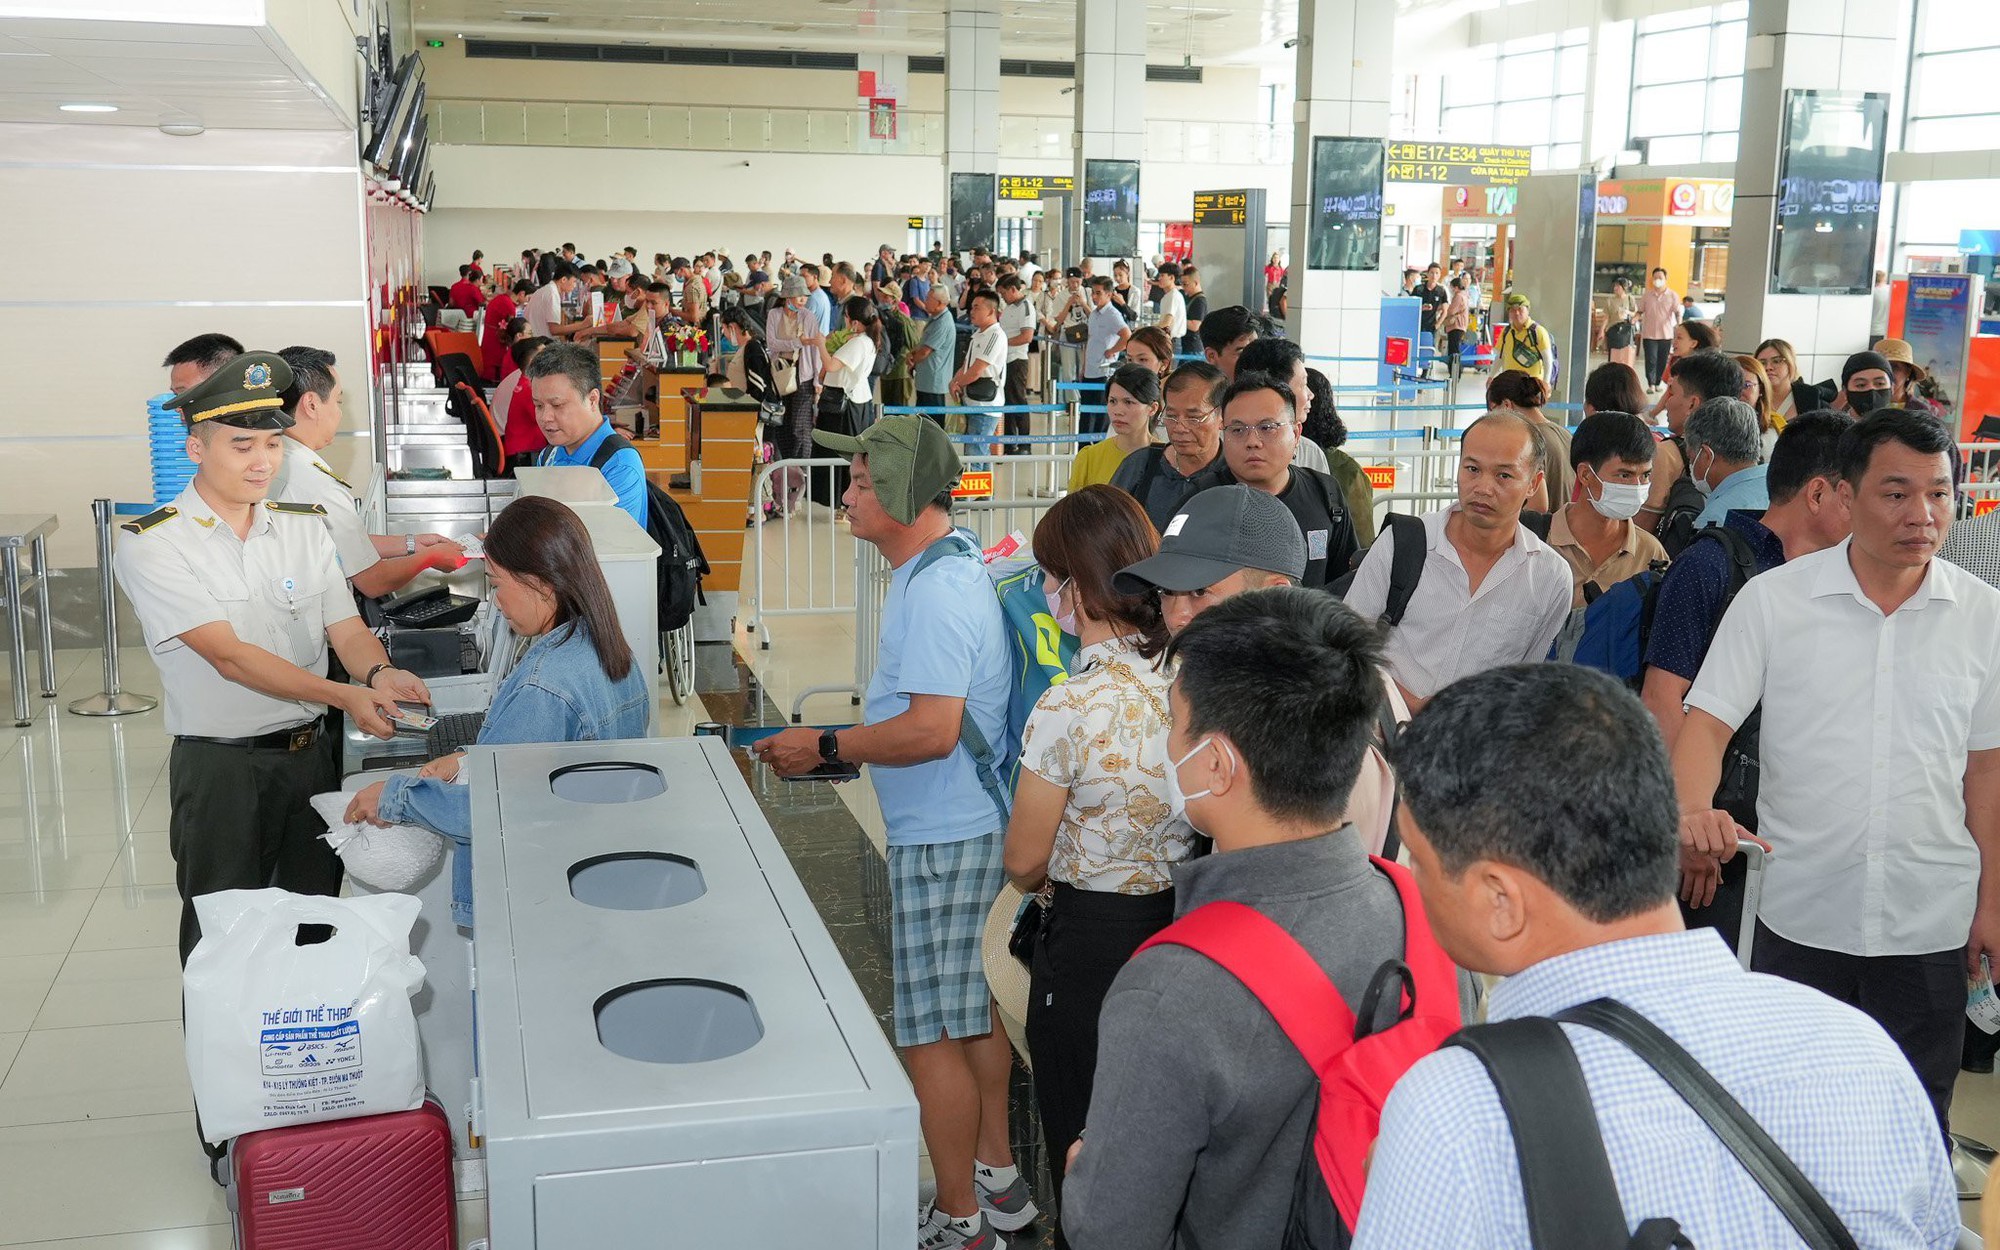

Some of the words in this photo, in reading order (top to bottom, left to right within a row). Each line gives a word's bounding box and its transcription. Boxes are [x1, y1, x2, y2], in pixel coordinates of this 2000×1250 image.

[1416, 144, 1478, 162] E17-E34
[1416, 165, 1448, 181] 1-12
[1022, 177, 1044, 187] 1-12
[957, 478, 990, 491] NHK
[262, 1007, 283, 1025] THẾ
[282, 1007, 302, 1024] GIỚI
[305, 1003, 325, 1022] THỂ
[326, 1006, 352, 1021] THAO
